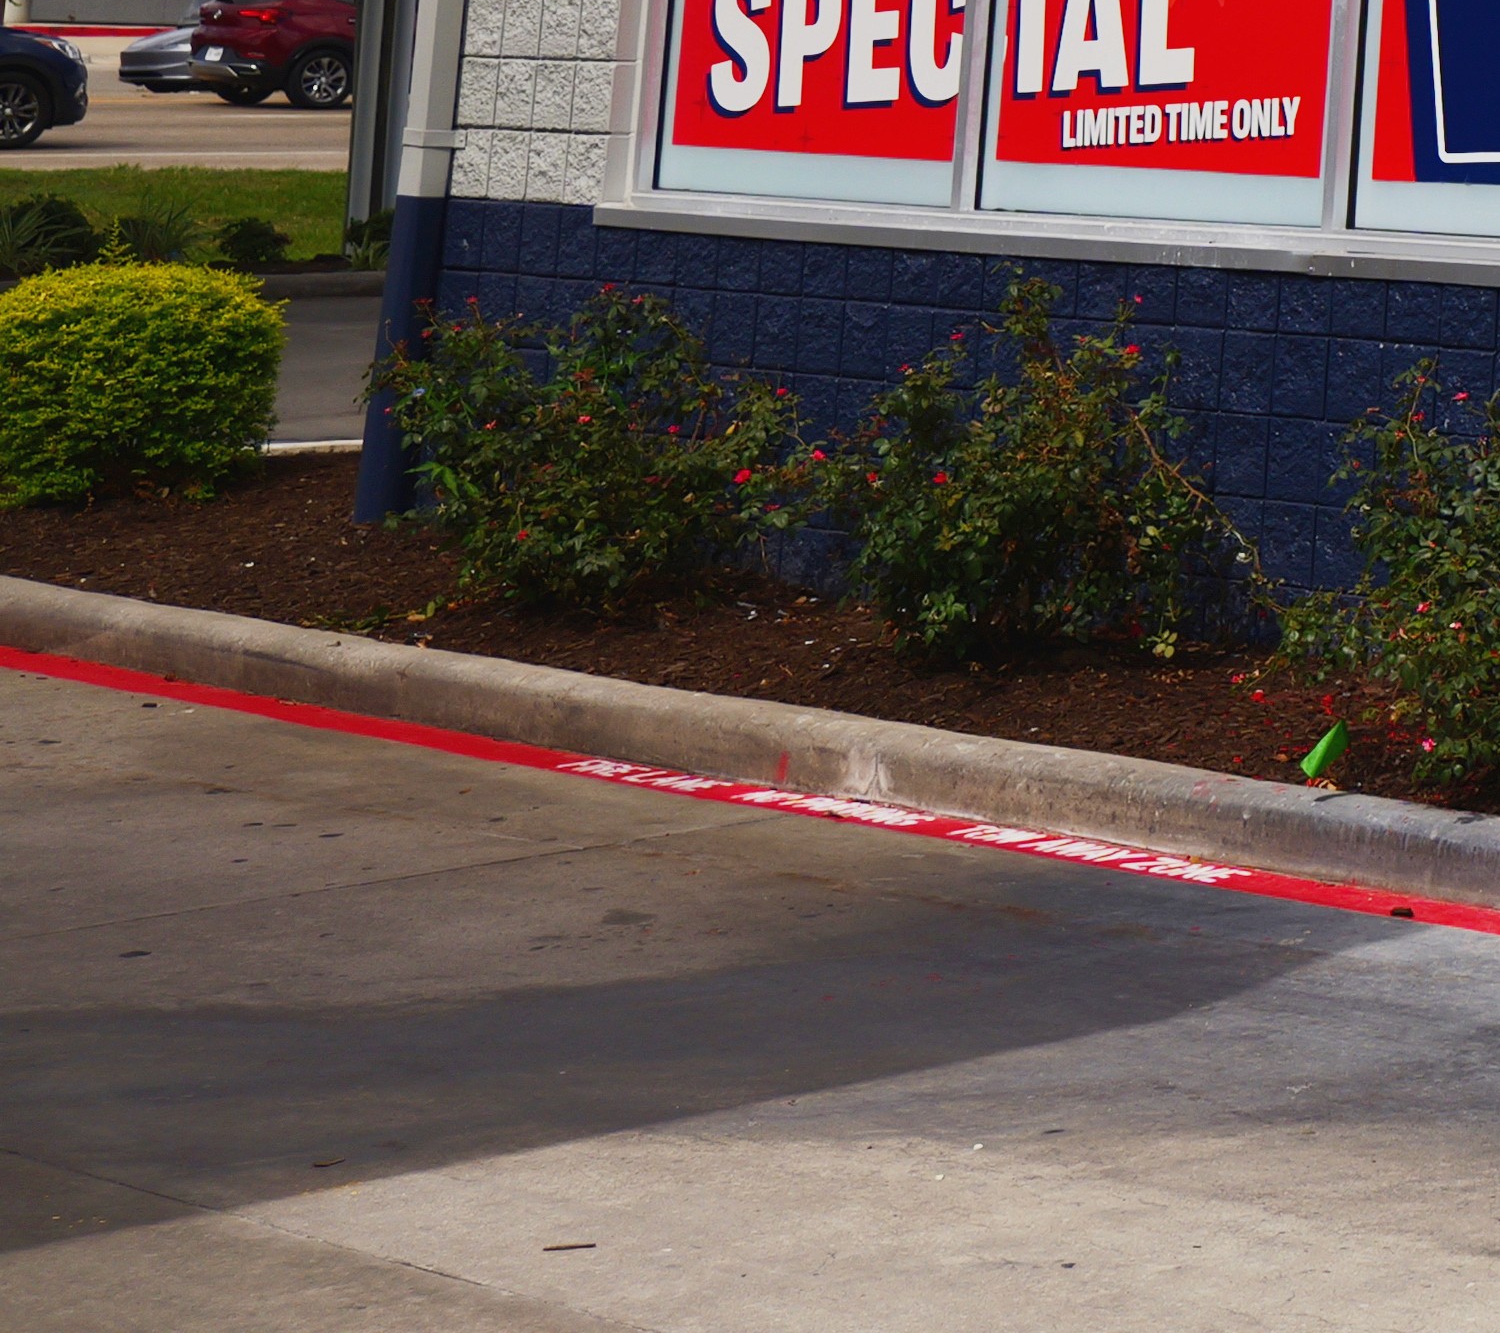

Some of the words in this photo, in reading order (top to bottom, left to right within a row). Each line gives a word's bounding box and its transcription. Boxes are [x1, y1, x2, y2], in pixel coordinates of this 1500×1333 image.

[1062, 104, 1162, 148] LIMITED
[1165, 100, 1229, 142] TIME
[1231, 96, 1301, 140] ONLY
[621, 771, 735, 792] LANE
[946, 825, 1047, 845] TOW
[1017, 839, 1150, 863] AWAY
[1119, 856, 1253, 884] ZONE
